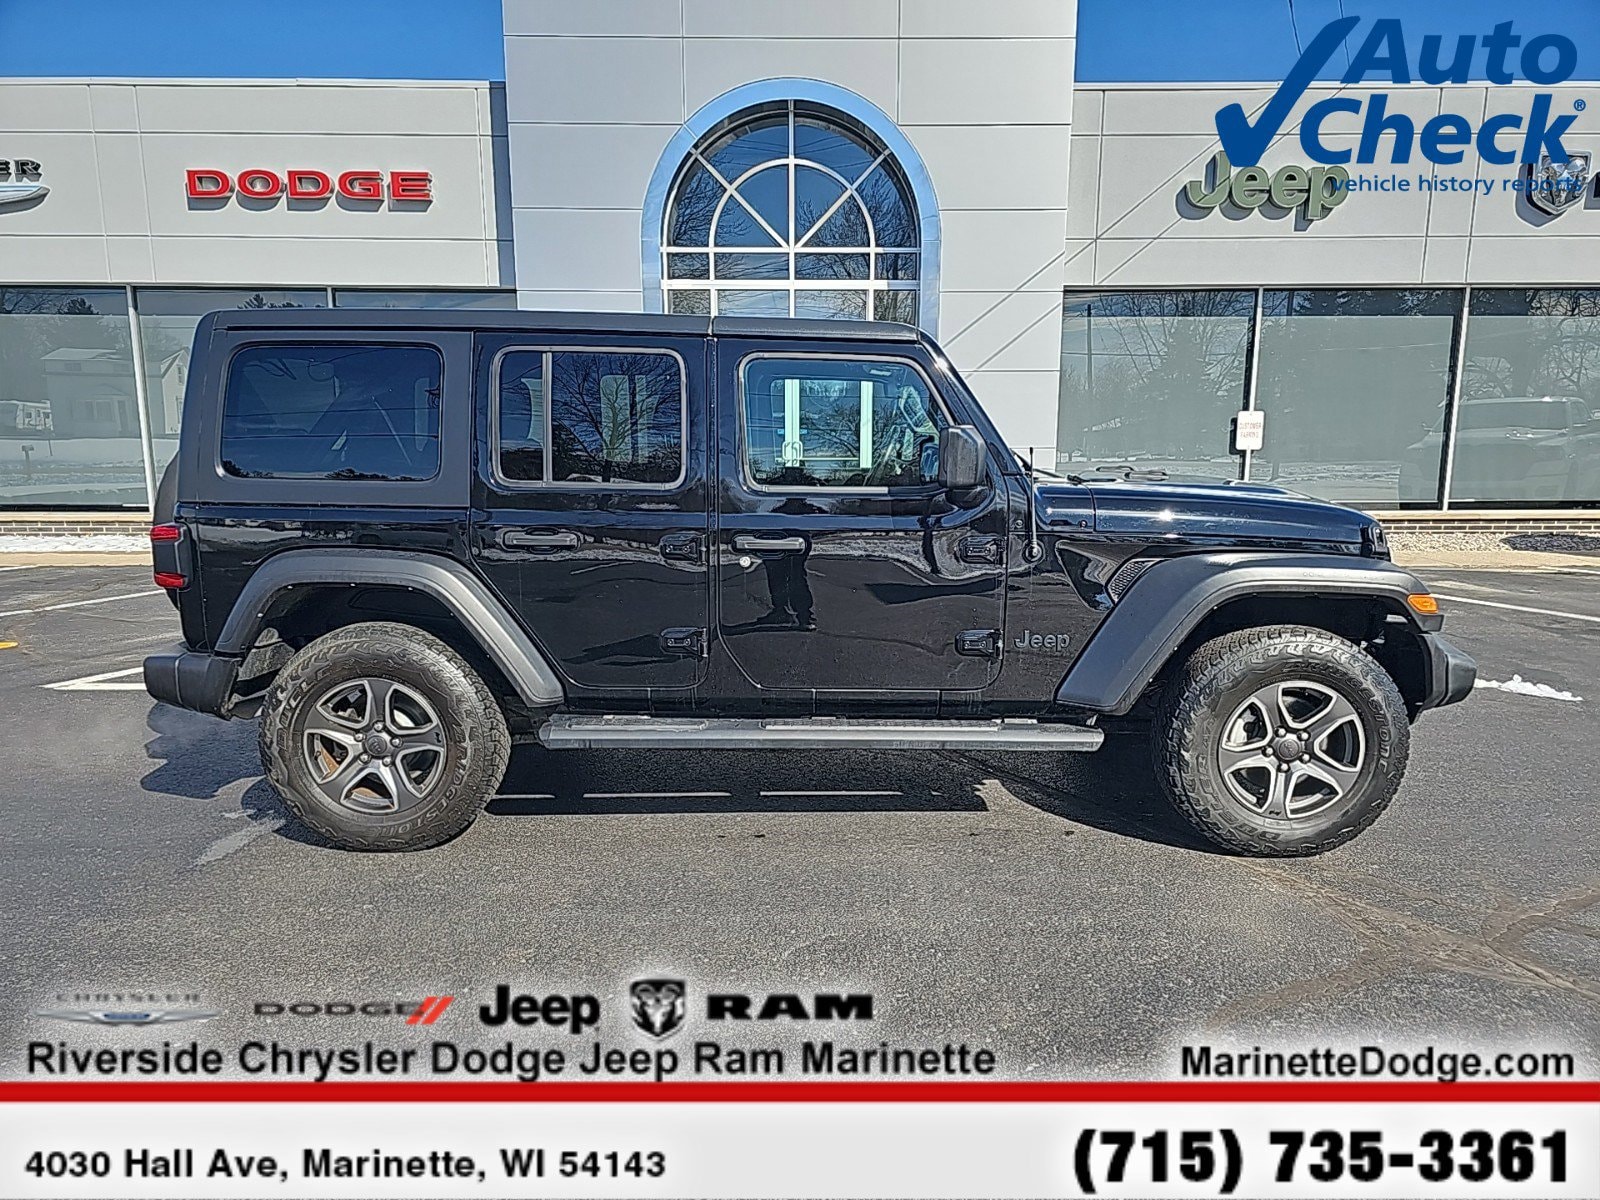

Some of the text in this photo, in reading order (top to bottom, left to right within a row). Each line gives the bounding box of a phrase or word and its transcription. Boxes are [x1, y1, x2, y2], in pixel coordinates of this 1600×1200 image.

[186, 168, 433, 201] DODGE
[1186, 150, 1349, 220] Jeep
[1014, 629, 1071, 650] Jeep
